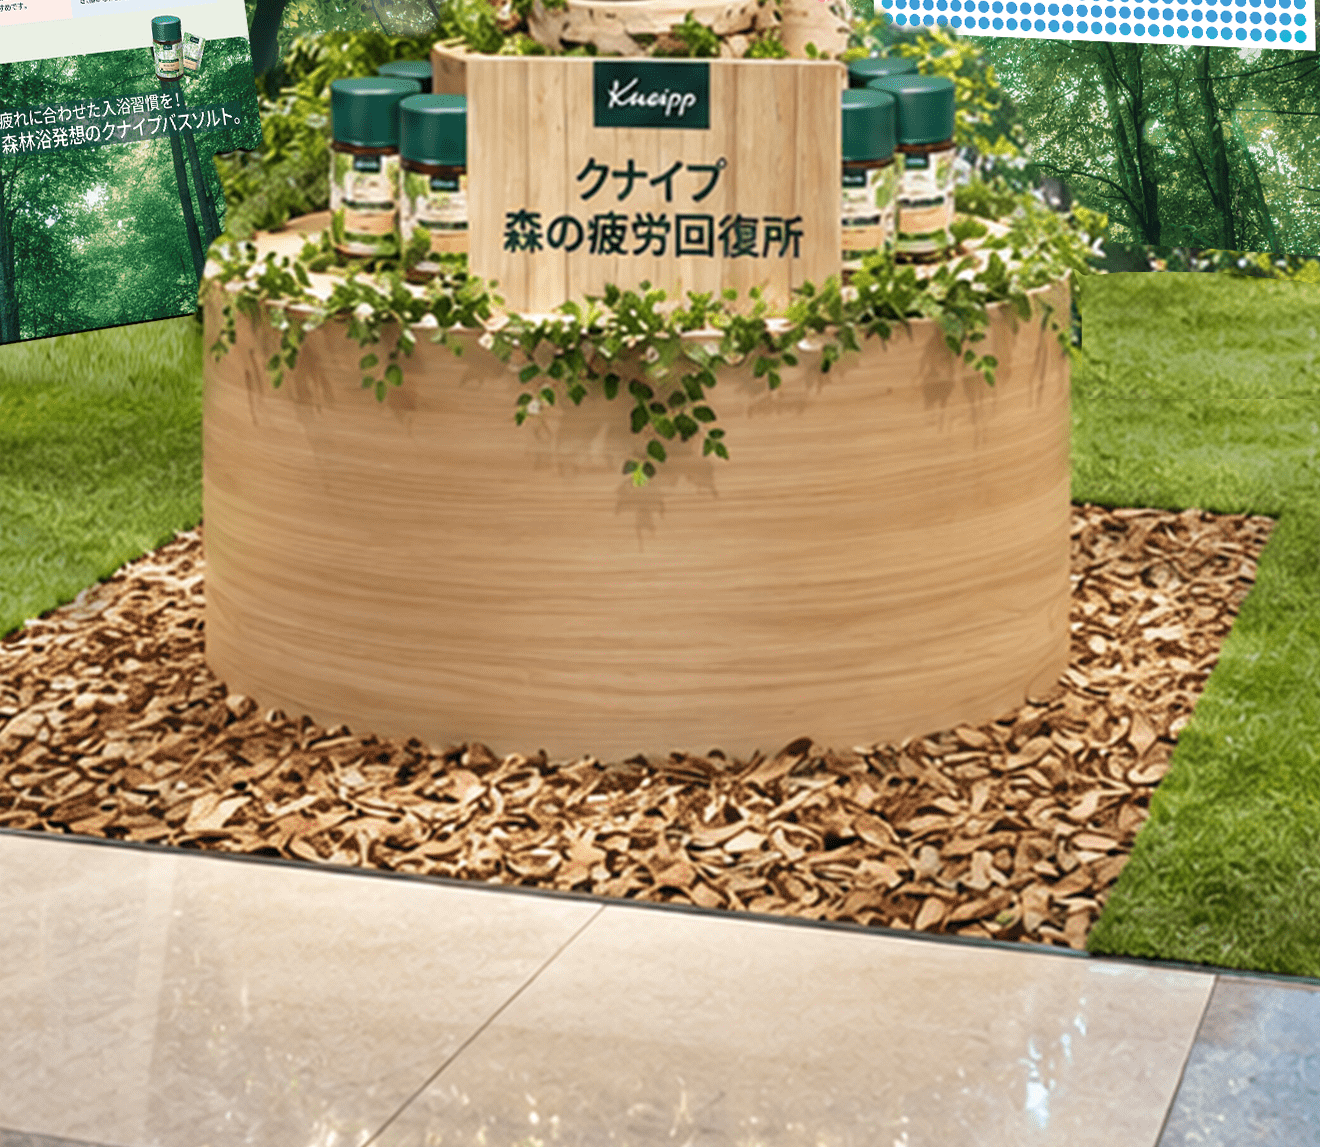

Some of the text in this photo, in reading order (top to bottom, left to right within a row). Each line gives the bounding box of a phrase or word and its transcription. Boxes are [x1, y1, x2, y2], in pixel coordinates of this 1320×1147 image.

[607, 77, 696, 116] Kneipp
[1, 107, 241, 154] 森林浴発想のクナイプバスソルト。
[576, 157, 727, 203] クナイプ
[504, 210, 804, 258] 森の疲労回復所
